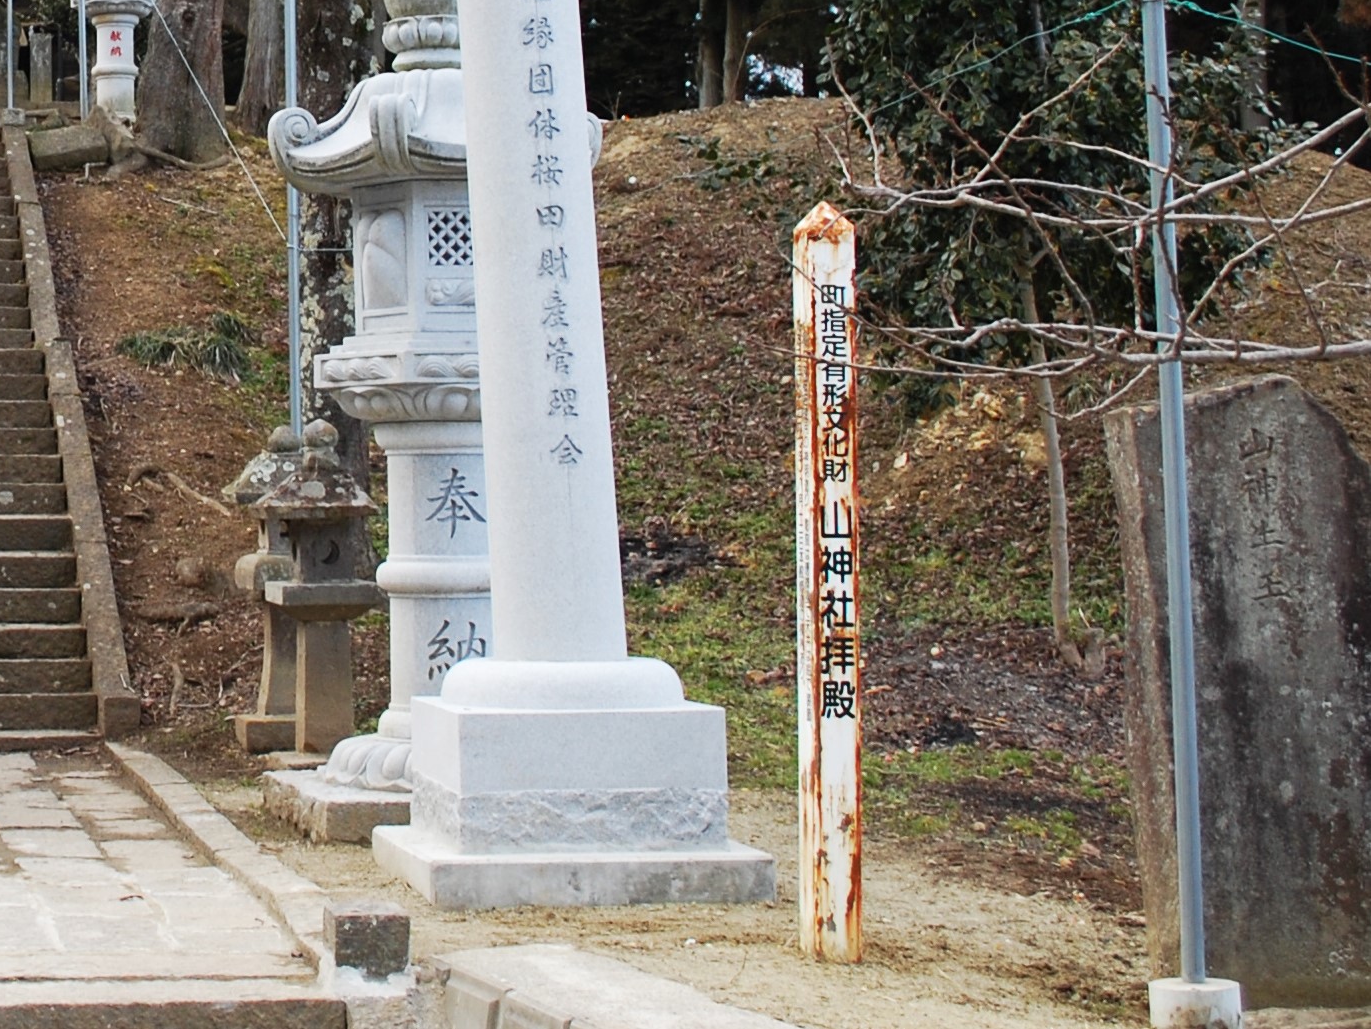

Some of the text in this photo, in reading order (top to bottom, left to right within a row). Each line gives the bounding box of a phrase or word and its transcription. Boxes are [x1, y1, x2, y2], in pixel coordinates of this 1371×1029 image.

[425, 467, 487, 681] 奉納
[820, 283, 856, 719] 町指定有形文化財 山神社拝殿
